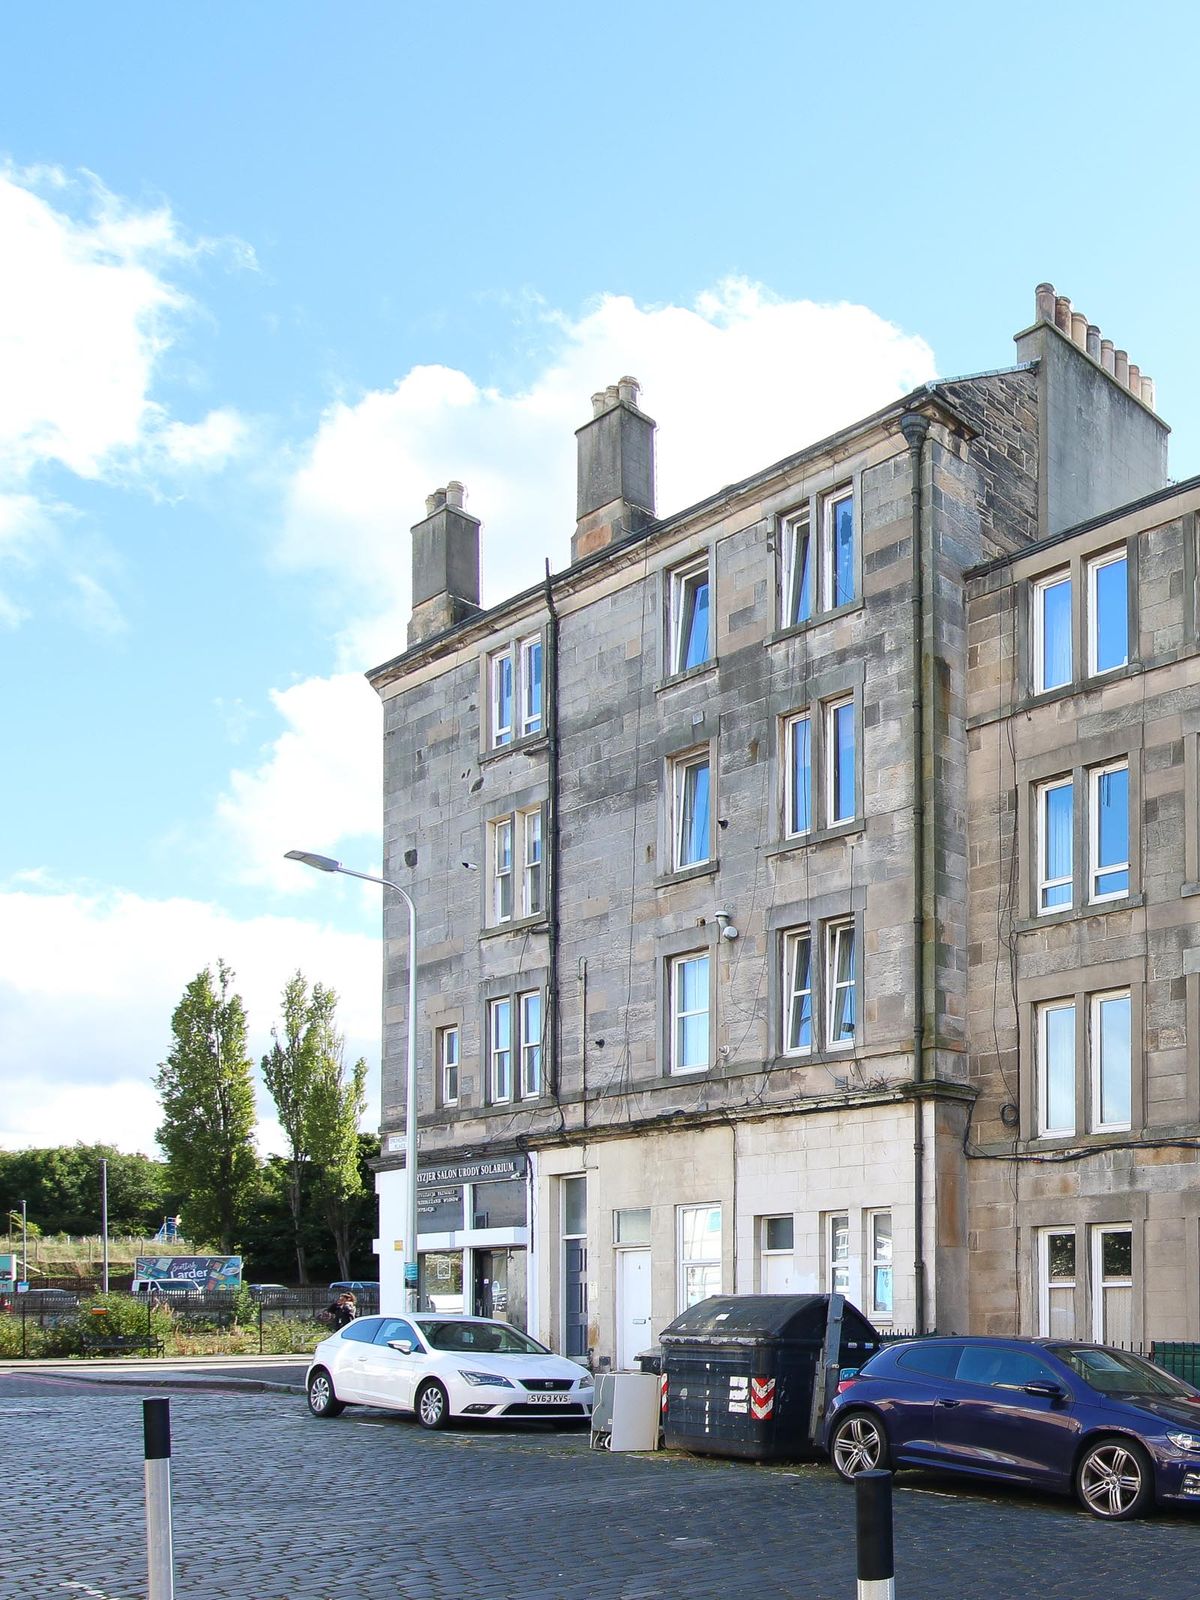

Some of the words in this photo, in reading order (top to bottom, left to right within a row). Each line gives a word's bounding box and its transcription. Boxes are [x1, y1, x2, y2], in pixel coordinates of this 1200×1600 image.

[437, 1168, 458, 1180] SALON
[458, 1166, 480, 1178] URODY
[480, 1162, 514, 1175] SOLARIUM
